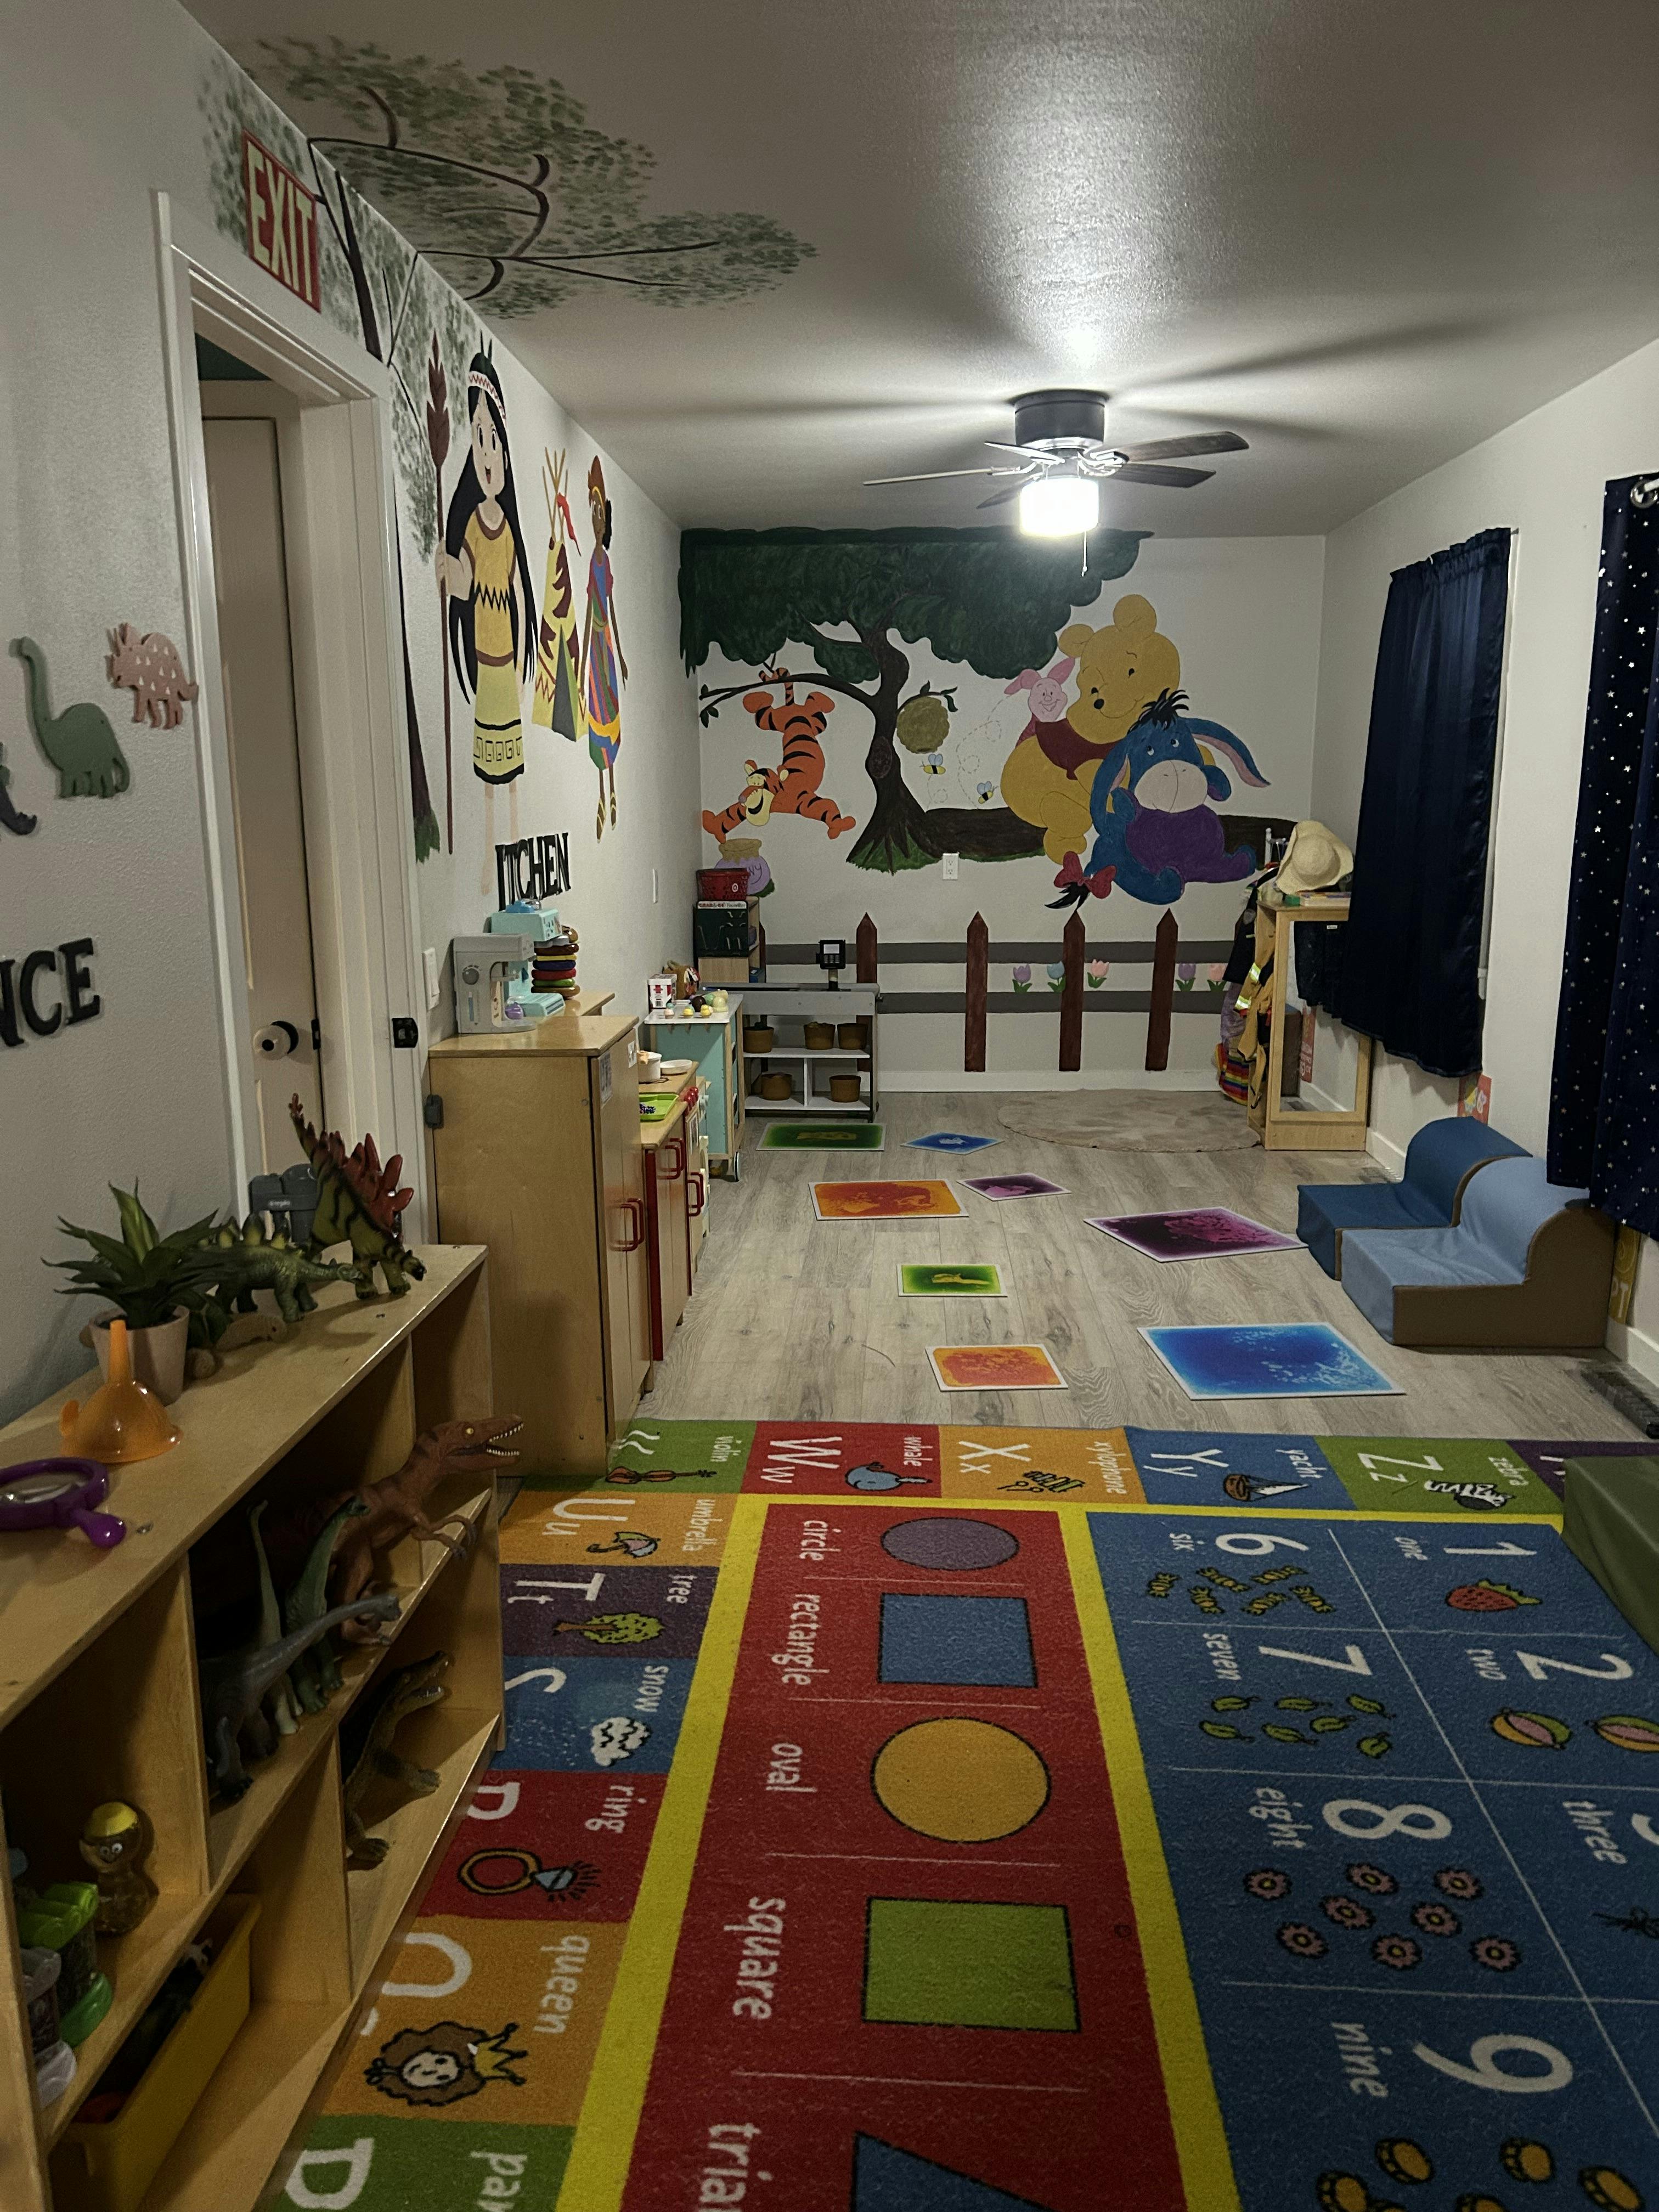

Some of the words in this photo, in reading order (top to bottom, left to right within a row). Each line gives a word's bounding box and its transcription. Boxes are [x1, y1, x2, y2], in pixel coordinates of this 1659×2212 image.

[247, 140, 313, 303] EXIT
[495, 832, 572, 911] ITCHEN
[710, 1436, 742, 1462] violin
[904, 1436, 933, 1466] whale
[1088, 1441, 1131, 1494] xylophone
[1279, 1450, 1325, 1478] yacht
[1487, 1457, 1528, 1488] zebra
[682, 1499, 723, 1551] umbrella
[799, 1520, 841, 1560] circle
[1170, 1533, 1199, 1550] six
[1216, 1533, 1308, 1555] 6
[1394, 1537, 1428, 1560] one
[1443, 1542, 1537, 1555] 1
[667, 1575, 697, 1604] tree
[771, 1594, 828, 1685] rectangle
[1203, 1633, 1241, 1680] seven
[1259, 1645, 1372, 1675] 7
[1465, 1649, 1506, 1680] two
[1516, 1651, 1633, 1680] 2
[633, 1666, 669, 1712] snow
[766, 1743, 815, 1792] oval
[585, 1786, 644, 1833] ring
[1249, 1787, 1313, 1848] eight
[1322, 1799, 1452, 1839] 8
[1562, 1801, 1626, 1864] three
[724, 1897, 786, 2019] square
[534, 1936, 590, 2033] queen
[1331, 2023, 1392, 2097] nine
[1413, 2033, 1573, 2093] 9
[698, 2123, 772, 2212] tria
